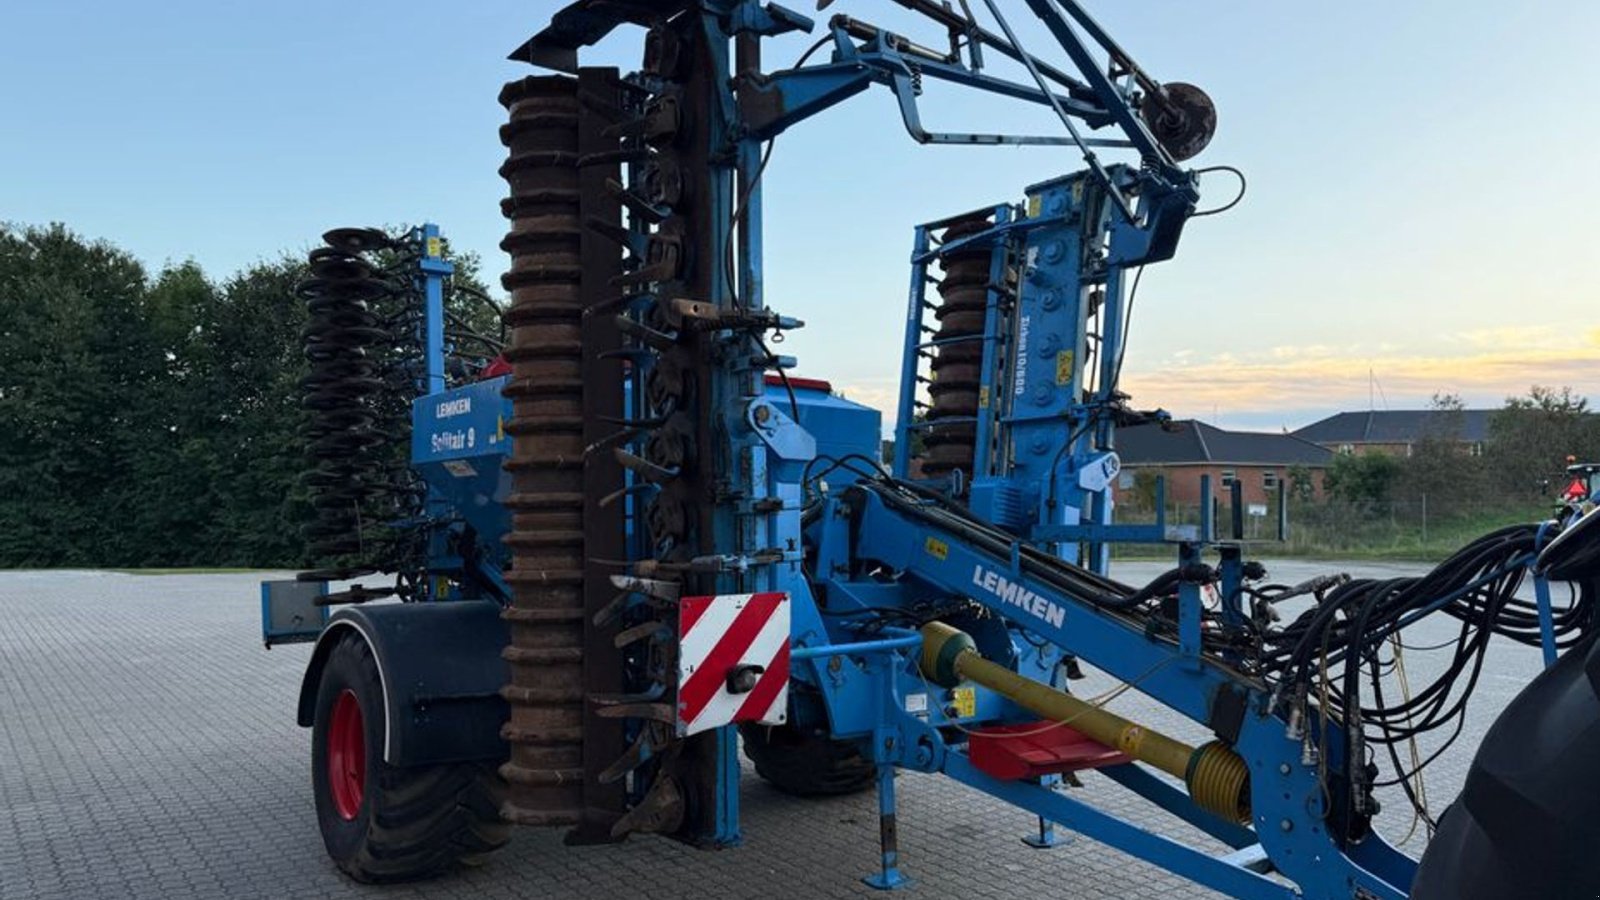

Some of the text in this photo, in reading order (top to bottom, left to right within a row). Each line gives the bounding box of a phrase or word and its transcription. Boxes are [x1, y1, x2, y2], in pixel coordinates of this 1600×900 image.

[436, 397, 471, 418] LEMKEN
[467, 427, 475, 448] 9
[973, 564, 1066, 629] LEMKEN
